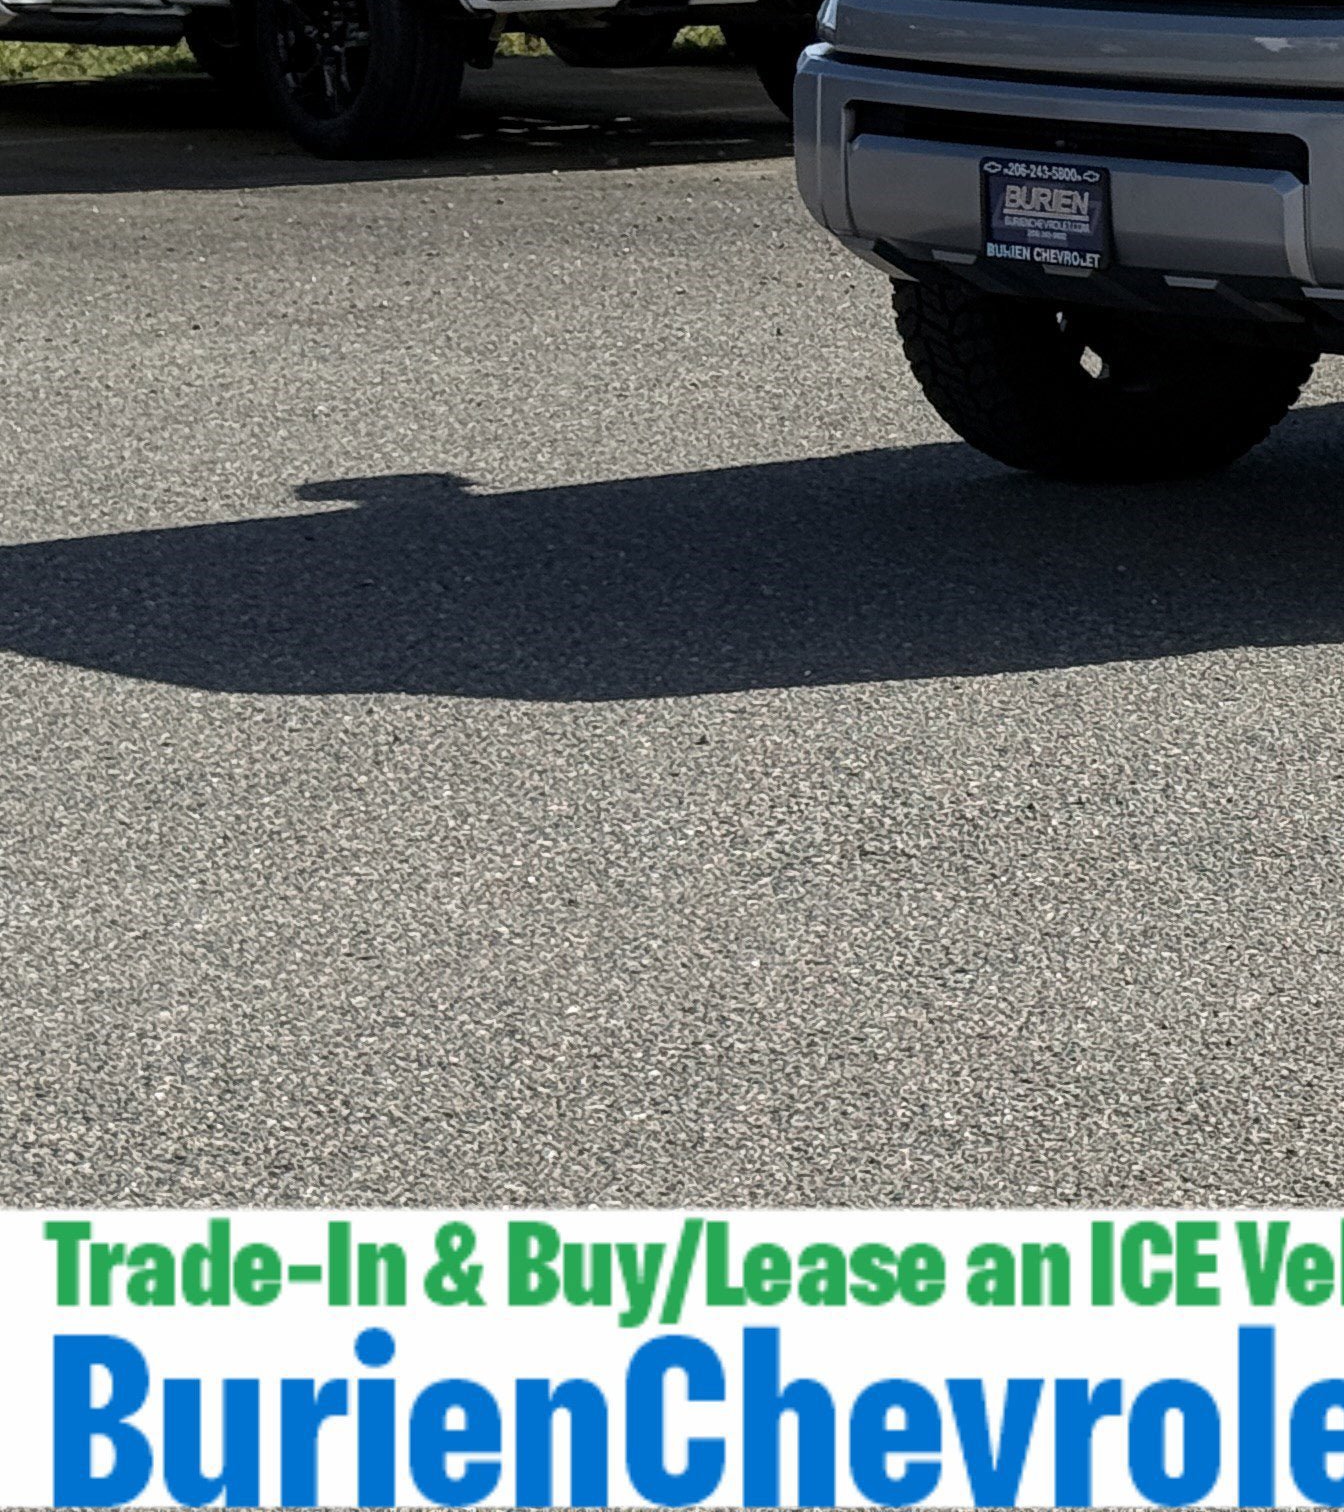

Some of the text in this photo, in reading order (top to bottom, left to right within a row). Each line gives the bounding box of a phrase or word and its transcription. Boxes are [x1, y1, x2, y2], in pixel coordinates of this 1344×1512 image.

[1005, 185, 1089, 215] BURIEN
[986, 242, 1100, 268] BURIEN CHEVROLET
